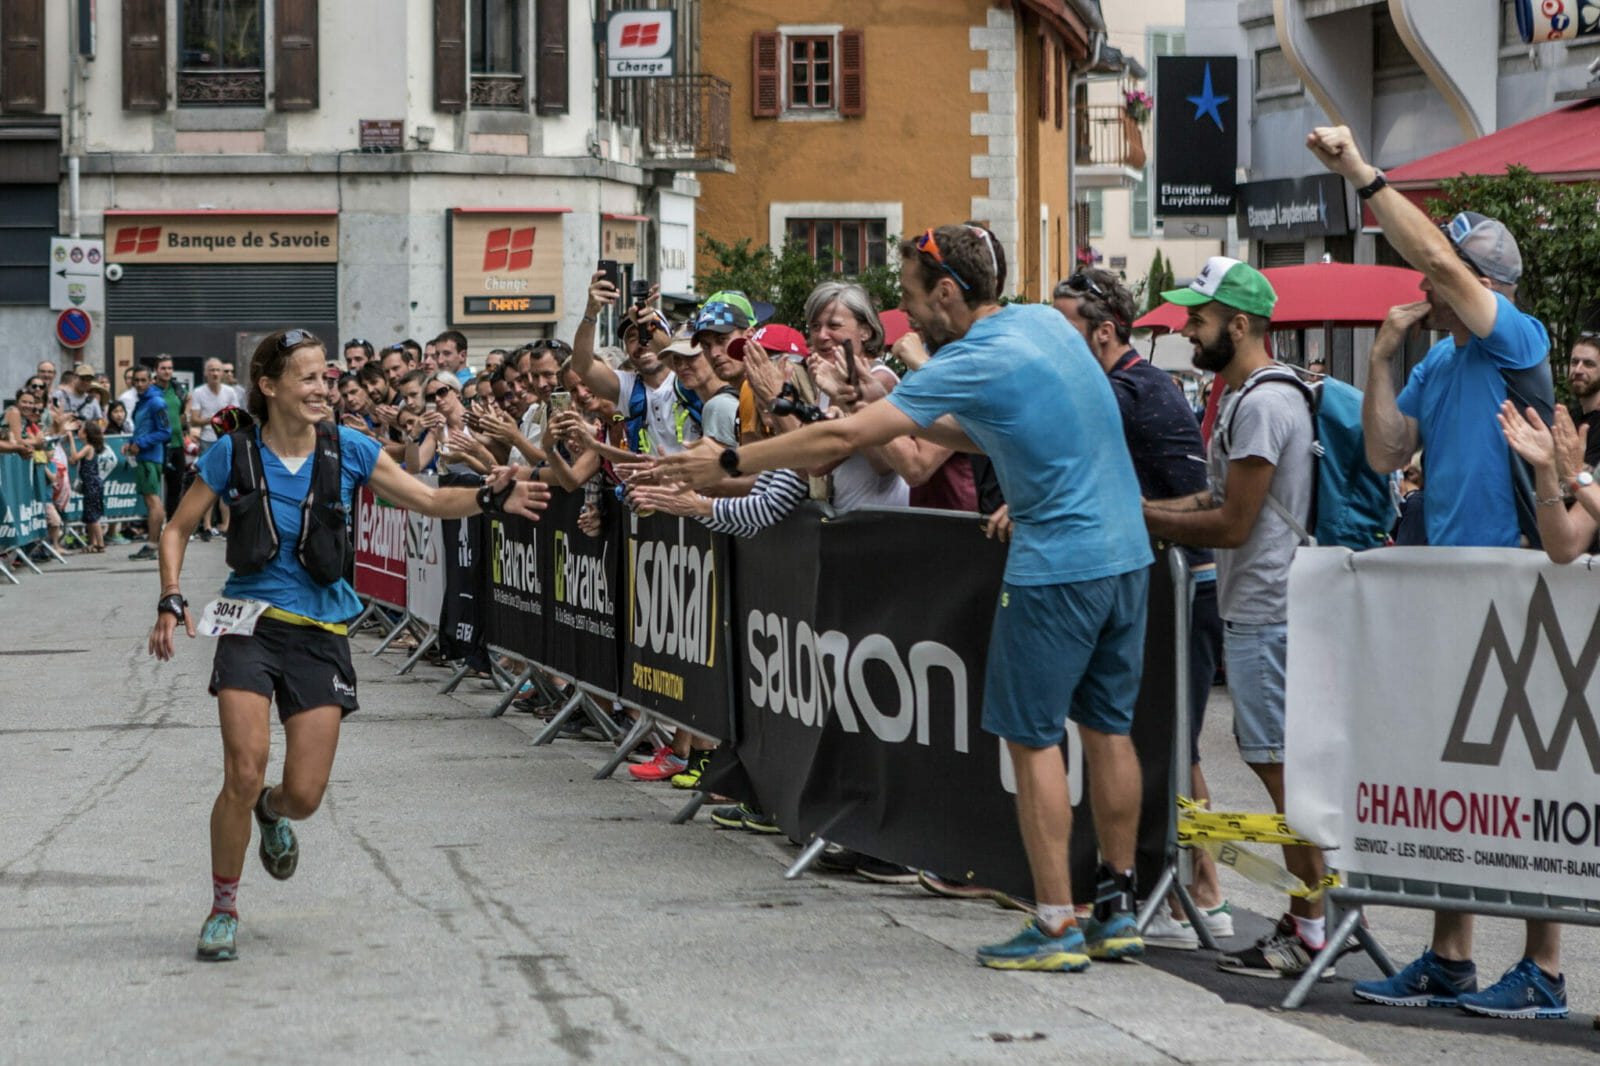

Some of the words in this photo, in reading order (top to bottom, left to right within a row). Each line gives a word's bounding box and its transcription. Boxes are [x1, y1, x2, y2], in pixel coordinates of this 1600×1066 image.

[617, 61, 664, 75] Change
[1161, 184, 1212, 197] Banque
[1161, 194, 1231, 208] Laydernier
[1248, 206, 1276, 231] Banque
[1277, 200, 1318, 229] Laydernier
[167, 232, 236, 251] Banque
[241, 231, 263, 247] de
[269, 231, 330, 247] Savoie
[484, 276, 528, 292] Change
[213, 601, 243, 619] 3041
[1356, 781, 1600, 848] CHAMONIX-MO
[1355, 837, 1388, 855] SERVOZ
[1398, 842, 1416, 858] LES
[1419, 845, 1465, 864] HOUCHES
